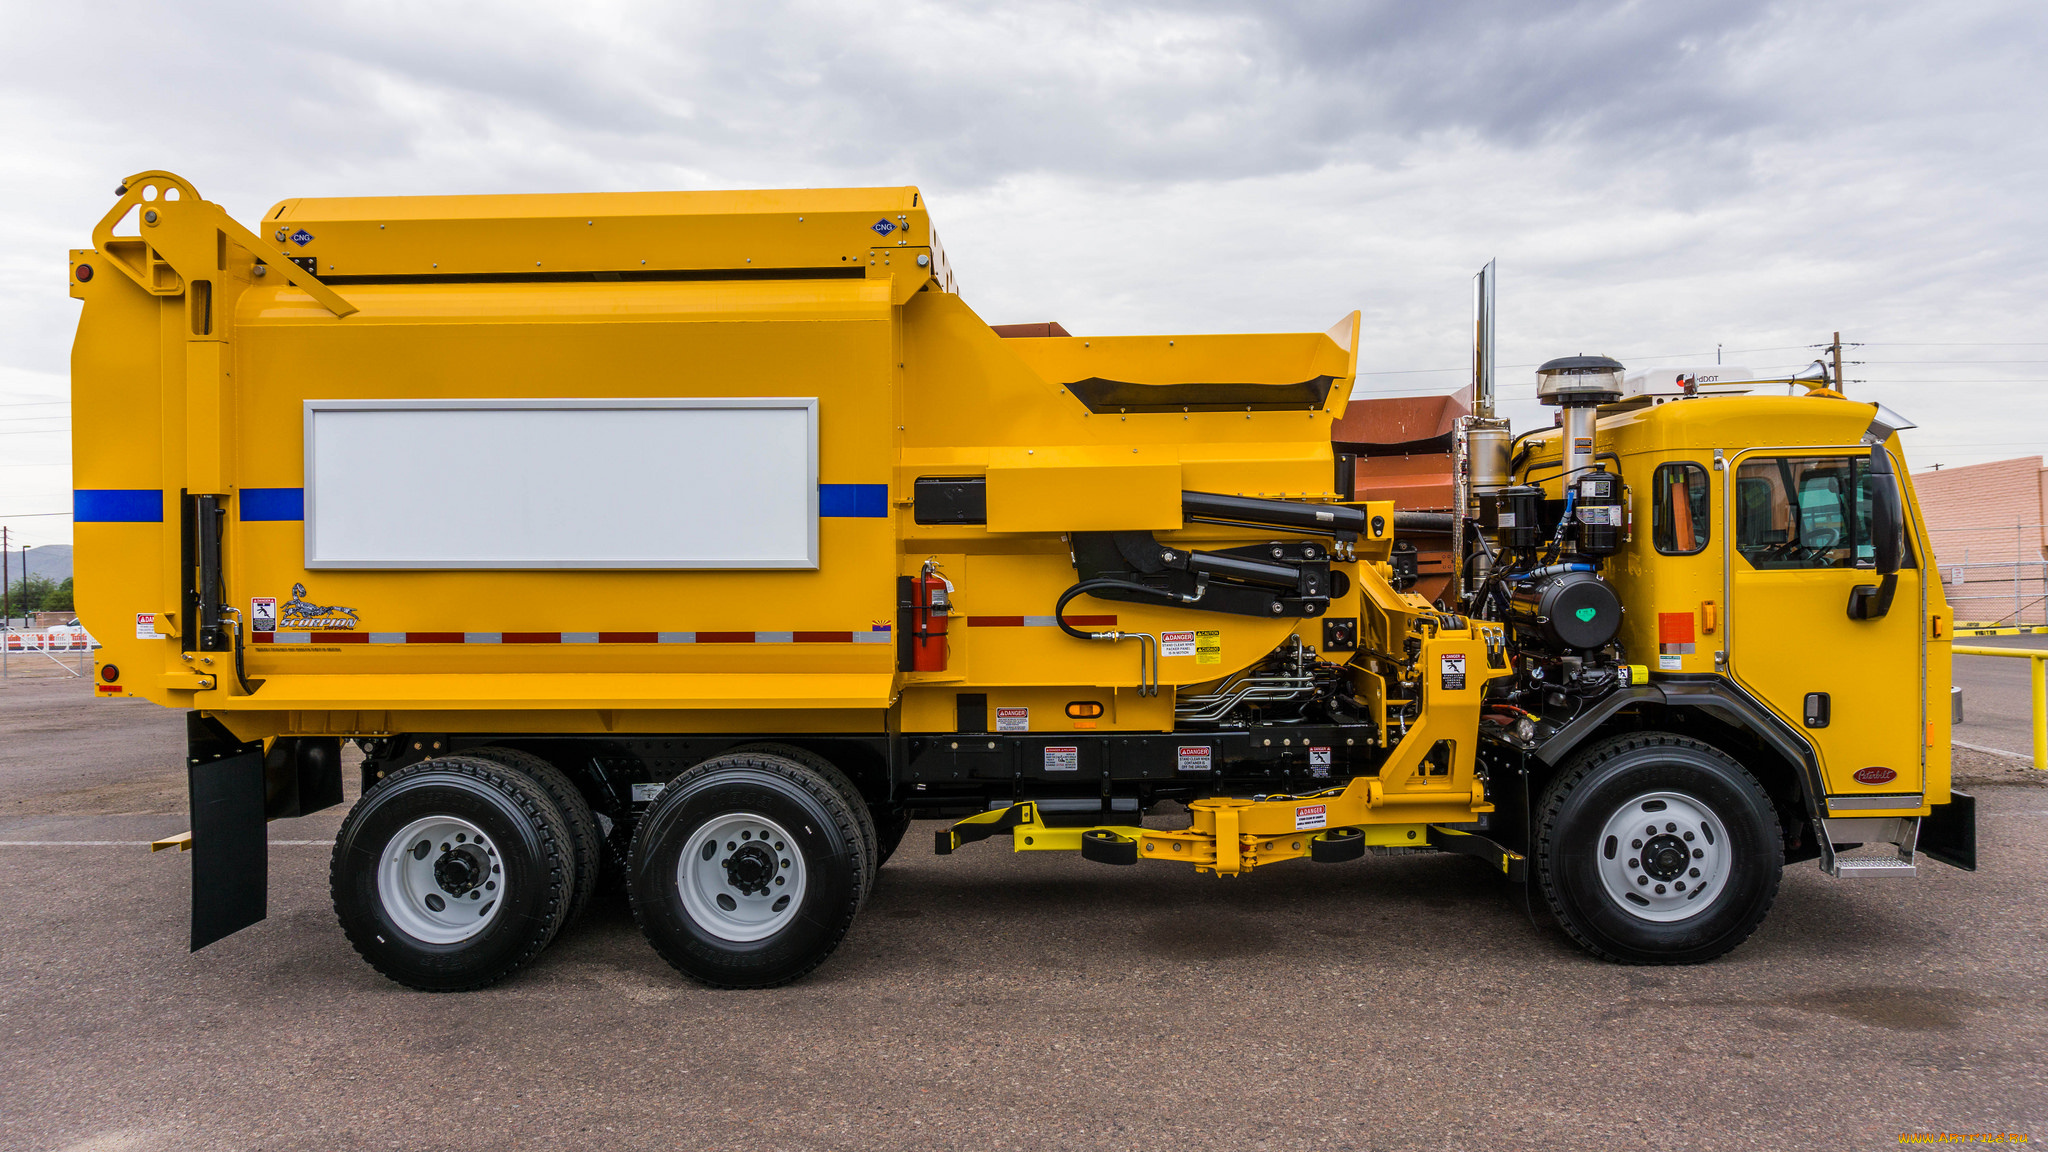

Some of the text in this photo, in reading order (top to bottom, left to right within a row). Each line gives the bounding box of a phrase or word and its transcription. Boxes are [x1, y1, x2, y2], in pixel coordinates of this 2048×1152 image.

[875, 223, 893, 231] CNG
[279, 618, 357, 627] SCORPION
[1858, 769, 1894, 781] Peterbilt
